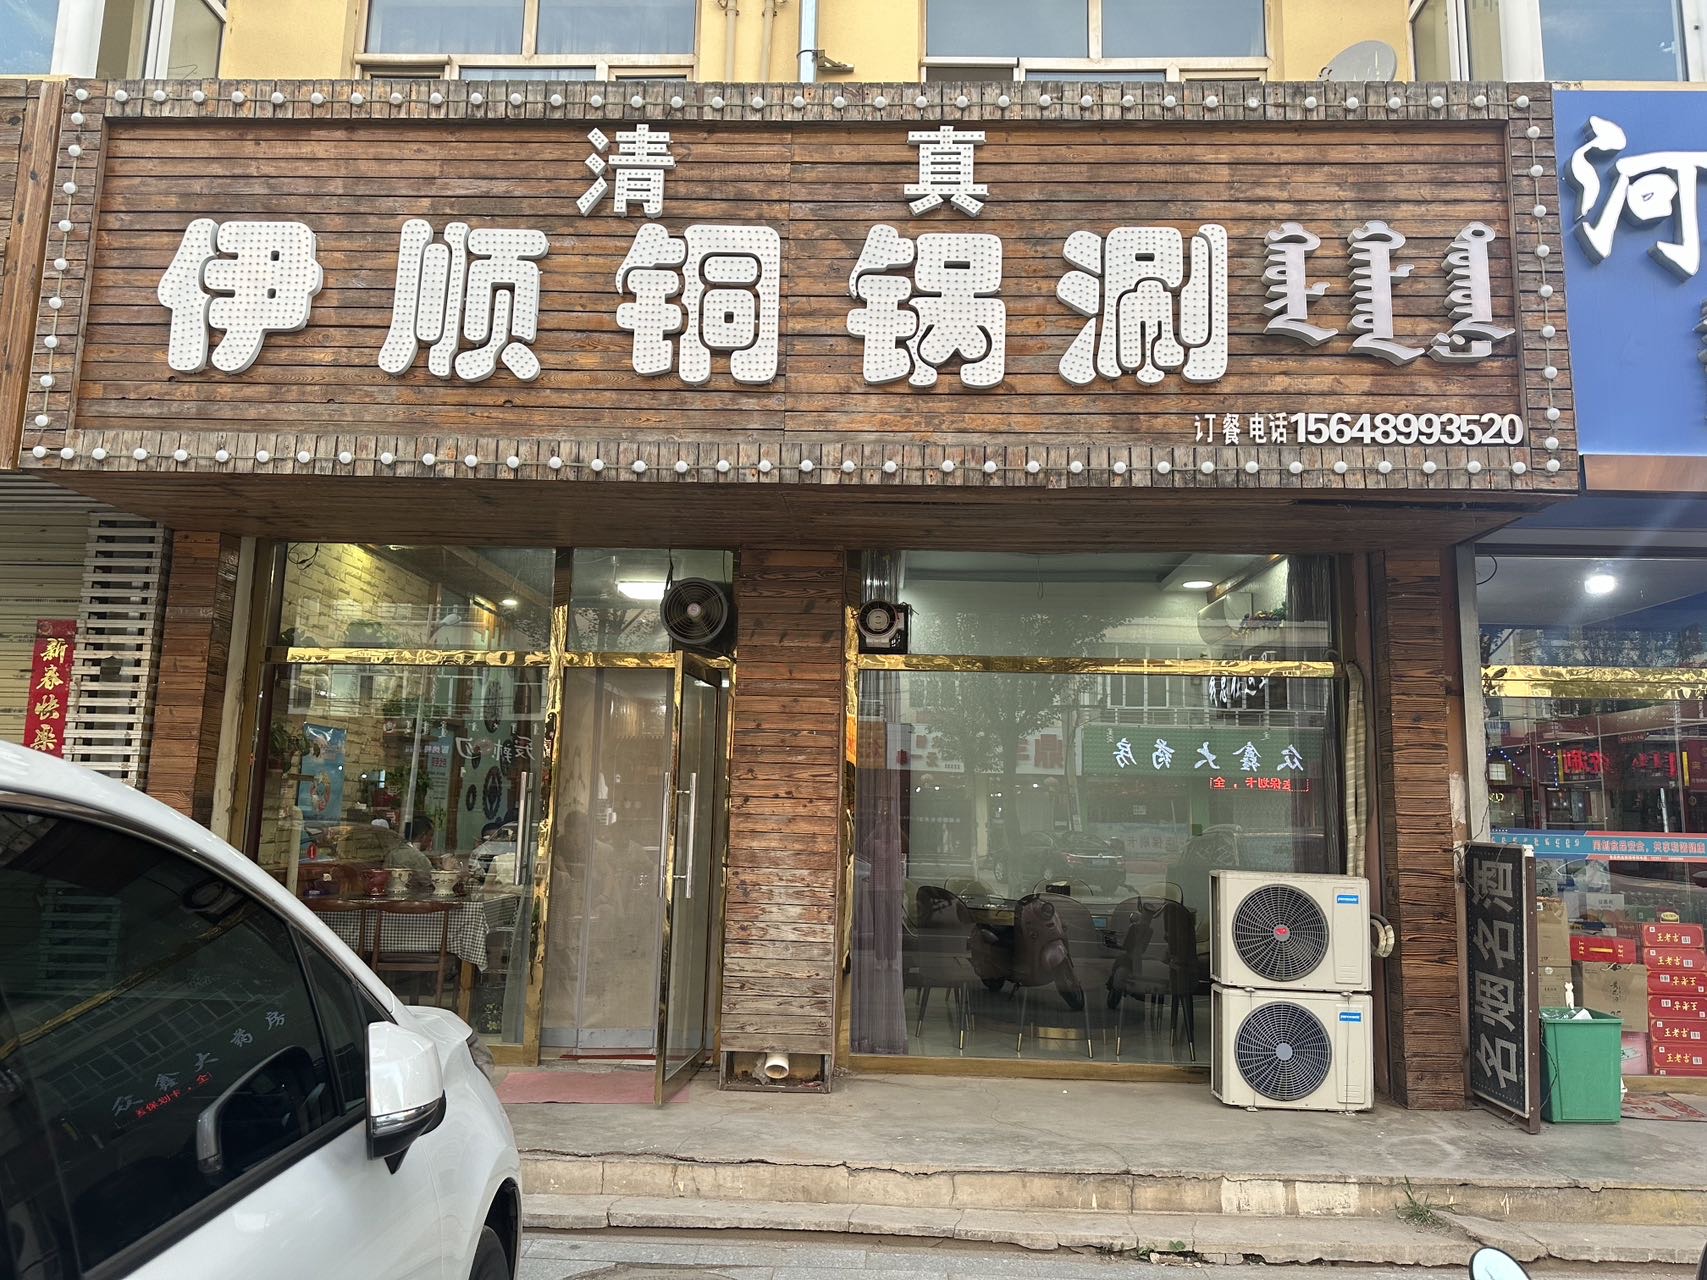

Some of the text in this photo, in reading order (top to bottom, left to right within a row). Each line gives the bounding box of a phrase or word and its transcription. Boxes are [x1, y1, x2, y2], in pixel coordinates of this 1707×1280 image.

[575, 123, 989, 219] 清真
[157, 218, 1229, 388] 伊顺铜锅涮
[1472, 857, 1518, 1089] 名烟名酒
